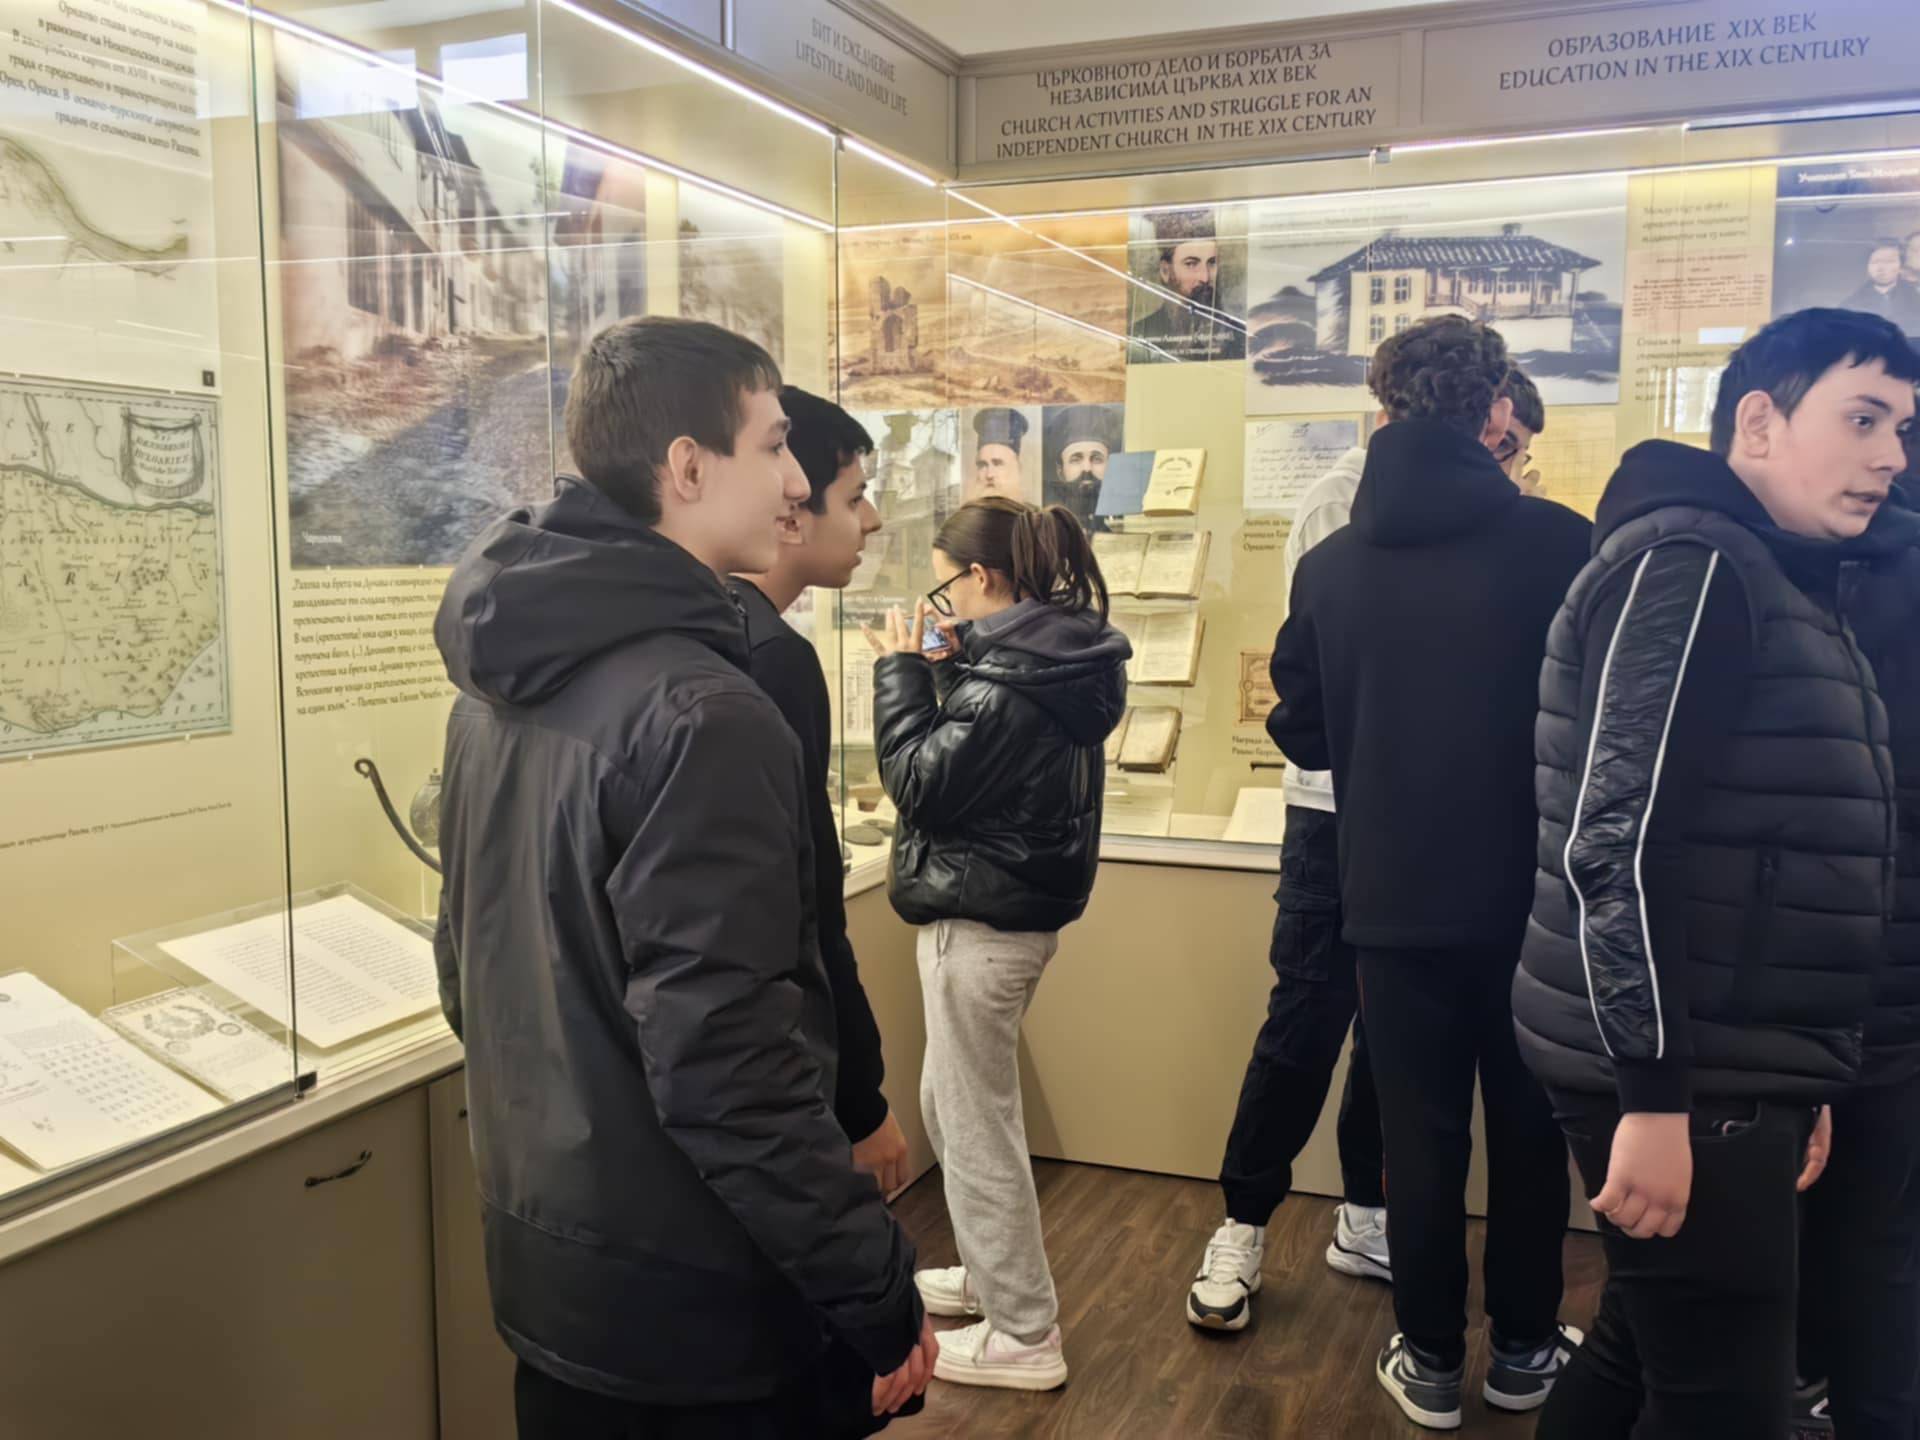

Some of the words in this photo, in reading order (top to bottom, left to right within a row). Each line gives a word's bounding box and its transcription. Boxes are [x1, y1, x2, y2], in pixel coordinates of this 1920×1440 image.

[812, 17, 832, 45] БИТ
[833, 29, 840, 51] И
[1548, 23, 1715, 58] ОБРАЗОВАНИЕ
[1727, 17, 1765, 40] XIX
[1773, 11, 1817, 35] ВЕК
[796, 39, 843, 82] LIFESTYLE
[845, 66, 865, 93] AND
[866, 77, 889, 105] DAILY
[891, 92, 908, 117] LIFE
[1036, 62, 1151, 91] ЦЪРКОВНОТО
[1155, 56, 1202, 80] ДЕЛО
[1208, 54, 1220, 70] И
[1225, 45, 1304, 68] БОРБАТА
[1308, 42, 1332, 61] ЗА
[1050, 79, 1168, 106] НЕЗАВИСИМА
[1173, 72, 1244, 97] ЦЪРКВА
[1249, 67, 1278, 86] XIX
[1283, 64, 1317, 83] ВЕК
[1500, 60, 1628, 90] EDUCATION
[1635, 56, 1659, 77] IN
[1664, 51, 1709, 73] THE
[1715, 47, 1753, 70] XIX
[1760, 37, 1871, 65] CENTURY
[997, 133, 1111, 159] INDEPENDENT
[1114, 127, 1188, 149] CHURCH
[1197, 124, 1215, 140] IN
[1219, 120, 1254, 139] THE
[1258, 117, 1288, 136] XIX
[1292, 108, 1377, 132] CENTURY
[1001, 115, 1071, 136] CHURCH
[1075, 105, 1164, 130] ACTIVITIES
[1168, 103, 1205, 121] AND
[1210, 93, 1301, 118] STRUGGLE
[1306, 88, 1341, 108] FOR
[1345, 86, 1372, 104] AN
